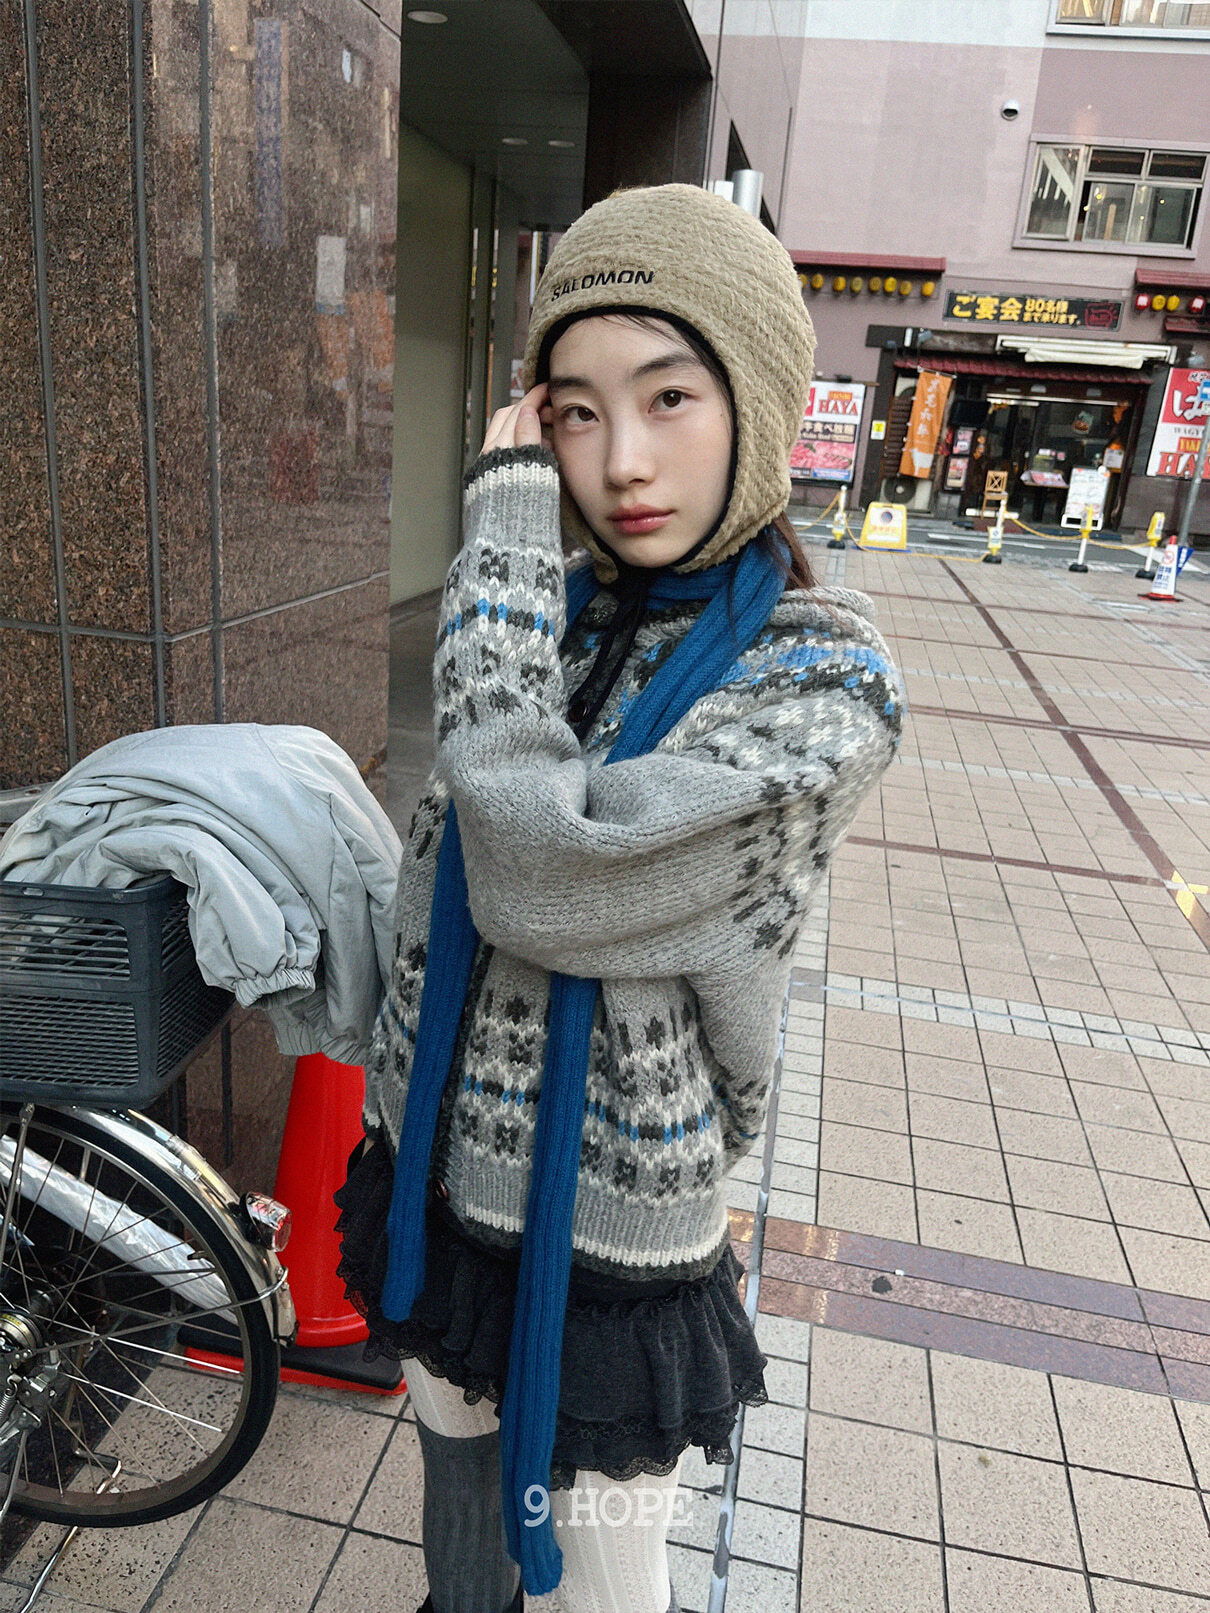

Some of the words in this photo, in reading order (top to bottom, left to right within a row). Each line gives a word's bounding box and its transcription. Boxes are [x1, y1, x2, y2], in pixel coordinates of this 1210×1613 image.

[551, 268, 654, 302] SALOMON
[952, 295, 1023, 321] ご宴会
[818, 399, 858, 416] HAYA
